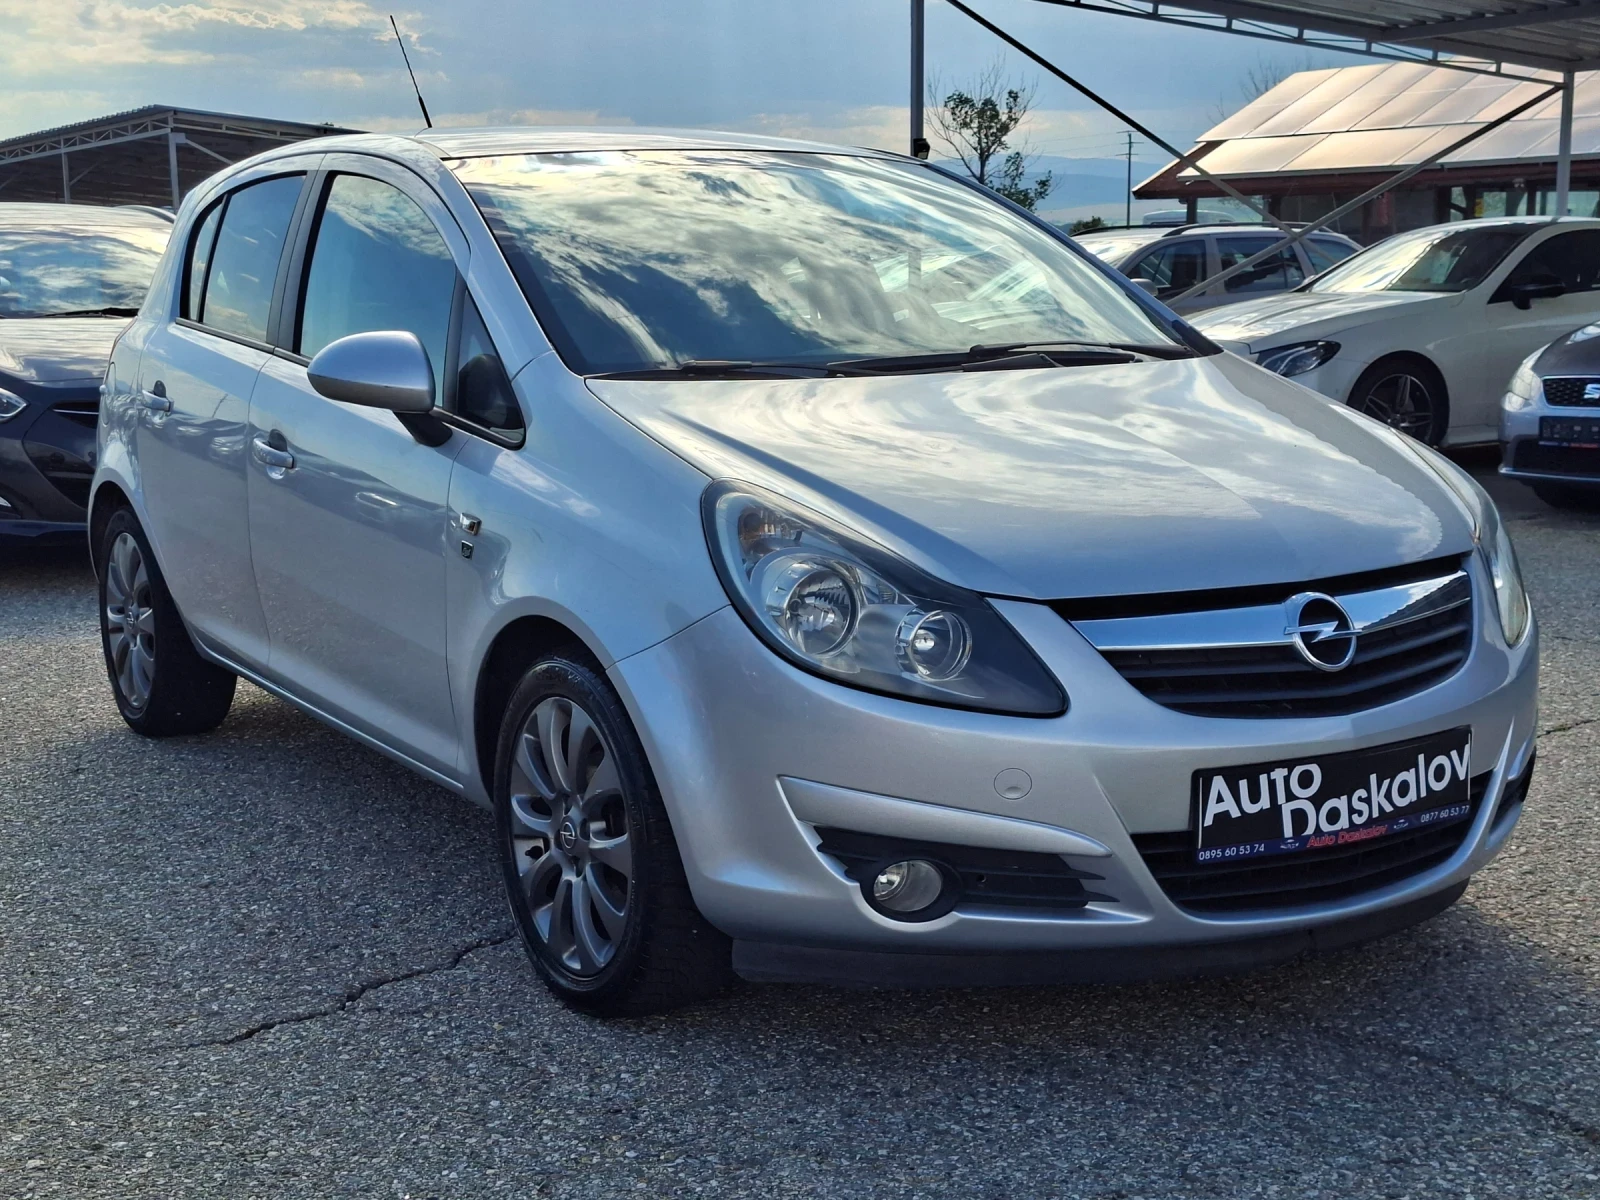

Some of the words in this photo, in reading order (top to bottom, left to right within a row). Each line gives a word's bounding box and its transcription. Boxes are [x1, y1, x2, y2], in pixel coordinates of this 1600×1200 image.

[1281, 744, 1470, 838] Daskalov
[1421, 812, 1438, 822] 0877
[1198, 849, 1222, 860] 0895
[1225, 847, 1236, 856] 60
[1239, 845, 1250, 854] 53
[1253, 843, 1264, 852] 74
